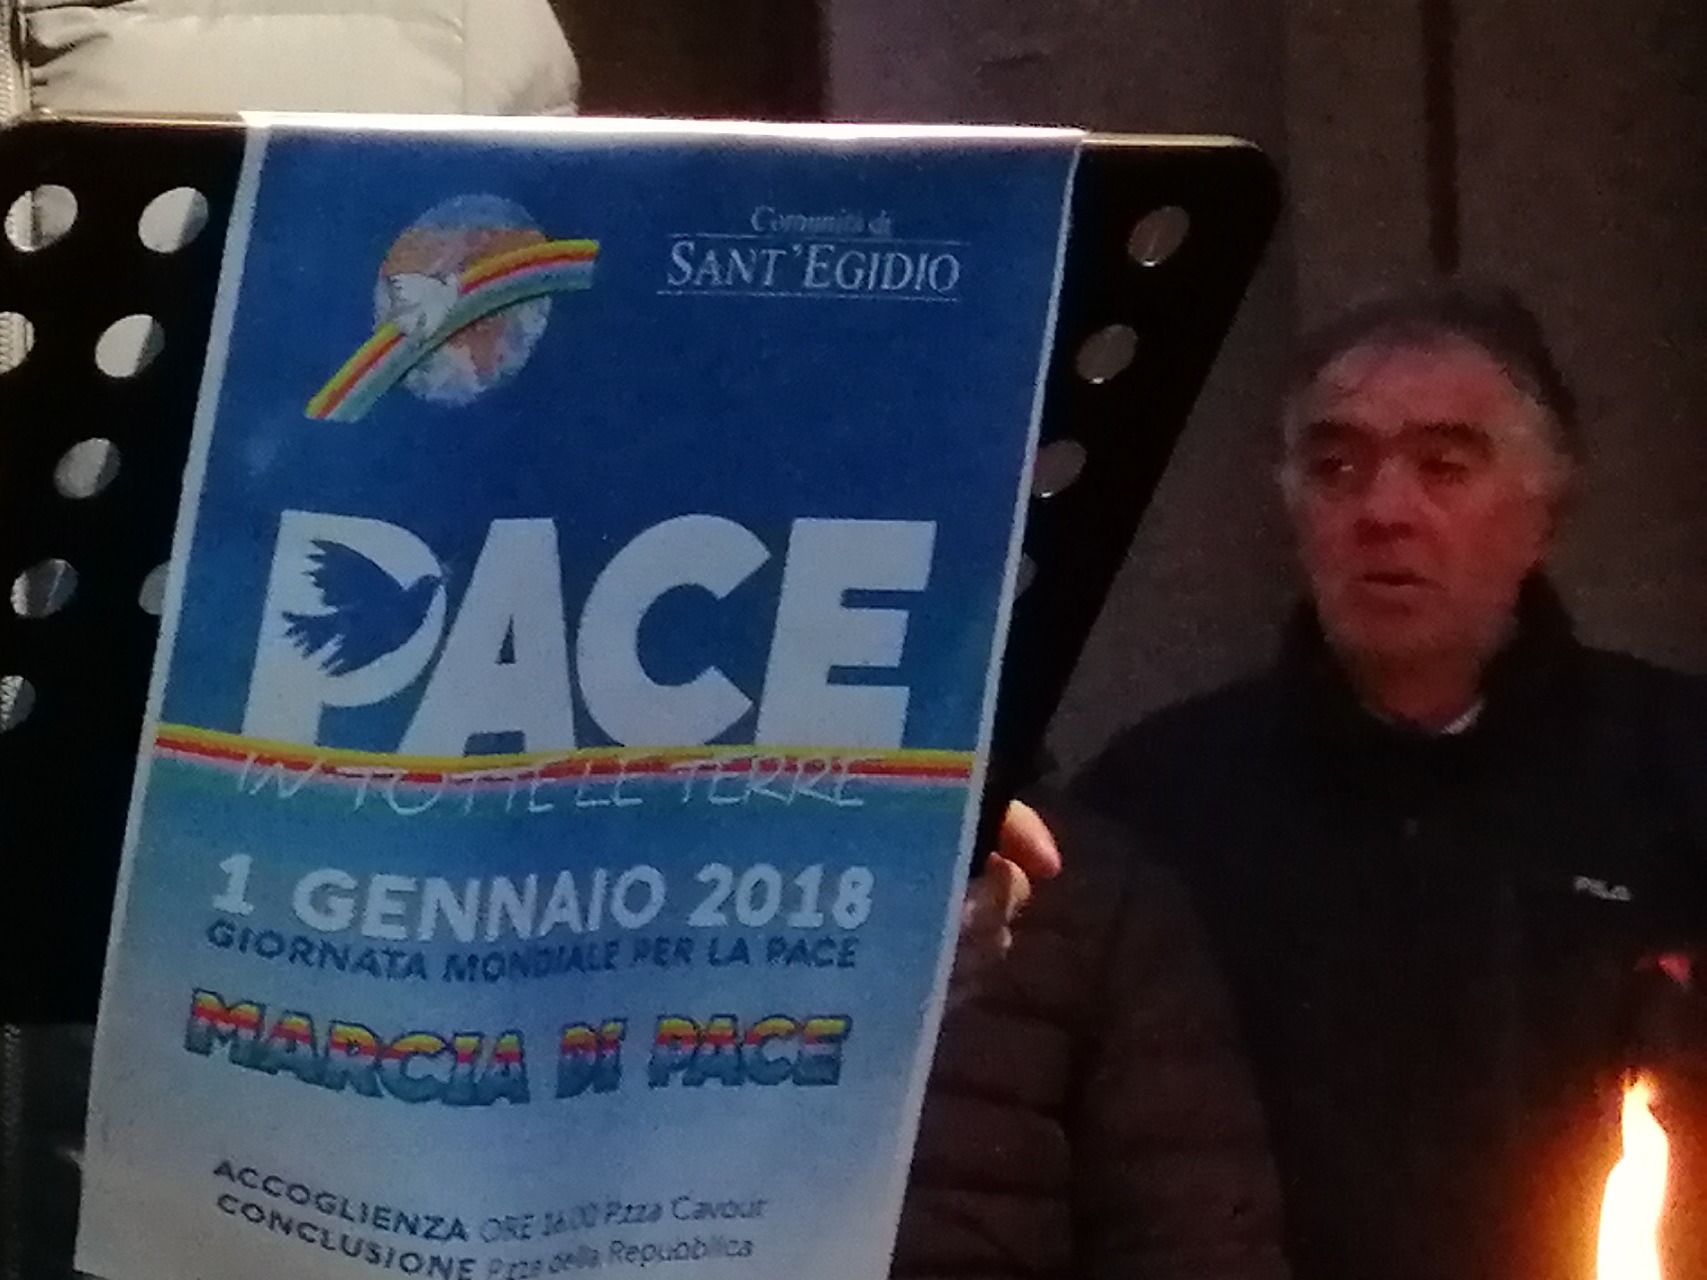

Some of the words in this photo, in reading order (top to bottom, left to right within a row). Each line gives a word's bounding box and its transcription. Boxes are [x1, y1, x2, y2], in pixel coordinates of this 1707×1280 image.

[241, 509, 937, 757] PACE
[670, 754, 865, 807] TERRE
[212, 853, 254, 916] 1
[292, 864, 666, 943] GENNAIO
[687, 862, 874, 930] 2018
[206, 918, 427, 982] GIORNATA
[443, 940, 620, 984] MONDIALE
[633, 936, 694, 967] PER
[707, 936, 751, 967] LA
[765, 935, 861, 968] PACE
[185, 987, 531, 1106] MARCIA
[556, 1019, 627, 1099] DI
[648, 1014, 852, 1089] PACE
[213, 1159, 470, 1243] ACCOGLIENZA
[670, 1193, 767, 1222] Cavour
